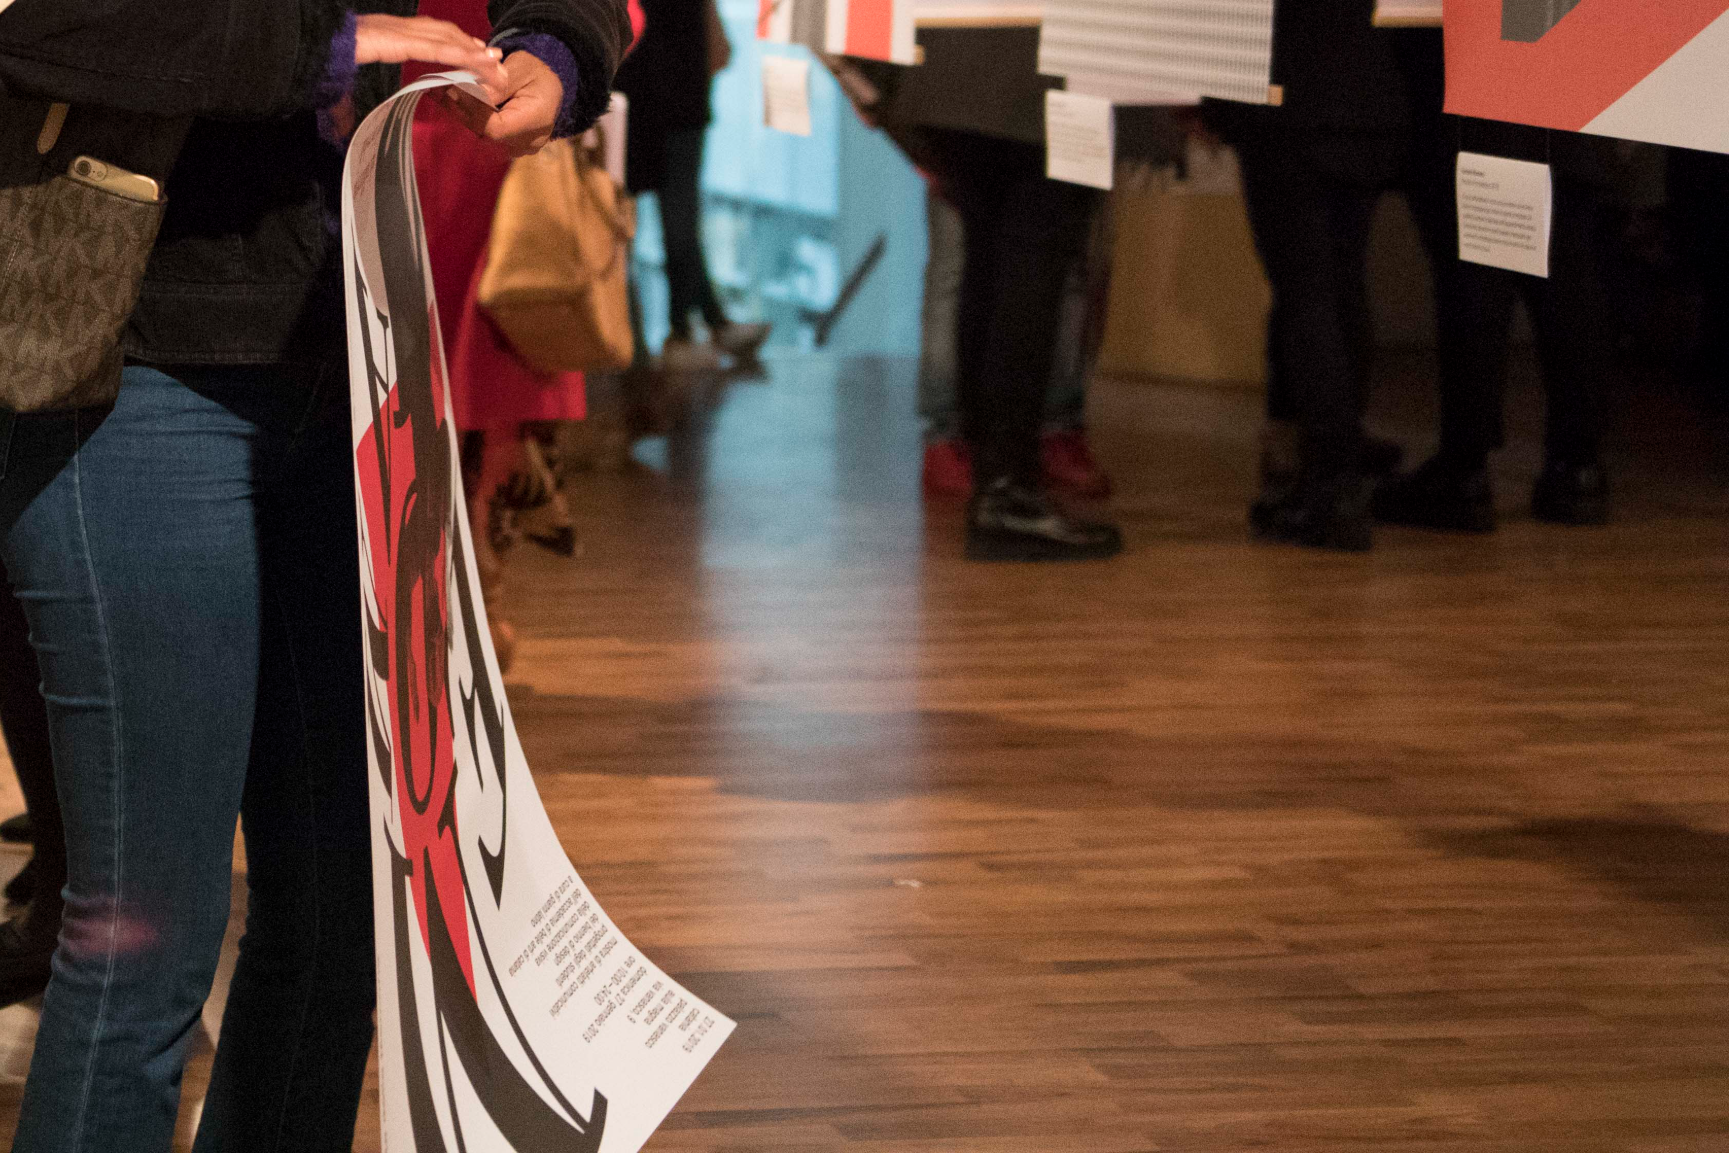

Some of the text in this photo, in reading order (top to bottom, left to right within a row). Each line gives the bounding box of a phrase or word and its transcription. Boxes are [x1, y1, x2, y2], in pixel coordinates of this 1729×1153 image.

[552, 889, 562, 903] di
[557, 878, 570, 896] cura
[532, 927, 548, 947] belle
[533, 899, 591, 969] della comunicazione visiva
[543, 922, 553, 936] di
[552, 912, 599, 968] del biennio di design
[521, 948, 531, 962] di
[526, 939, 538, 956] arti
[571, 947, 588, 969] degli
[507, 953, 526, 979] catania
[622, 954, 636, 969] ore
[548, 935, 619, 1019] mostra di artefatti comunicativi
[554, 961, 577, 989] studenti
[650, 979, 665, 993] via
[581, 964, 649, 1044] domenica 27 gennaio 2019
[641, 989, 676, 1026] aula magna
[663, 997, 689, 1025] palazzo
[625, 1013, 637, 1024] 9
[677, 1006, 701, 1033] catania
